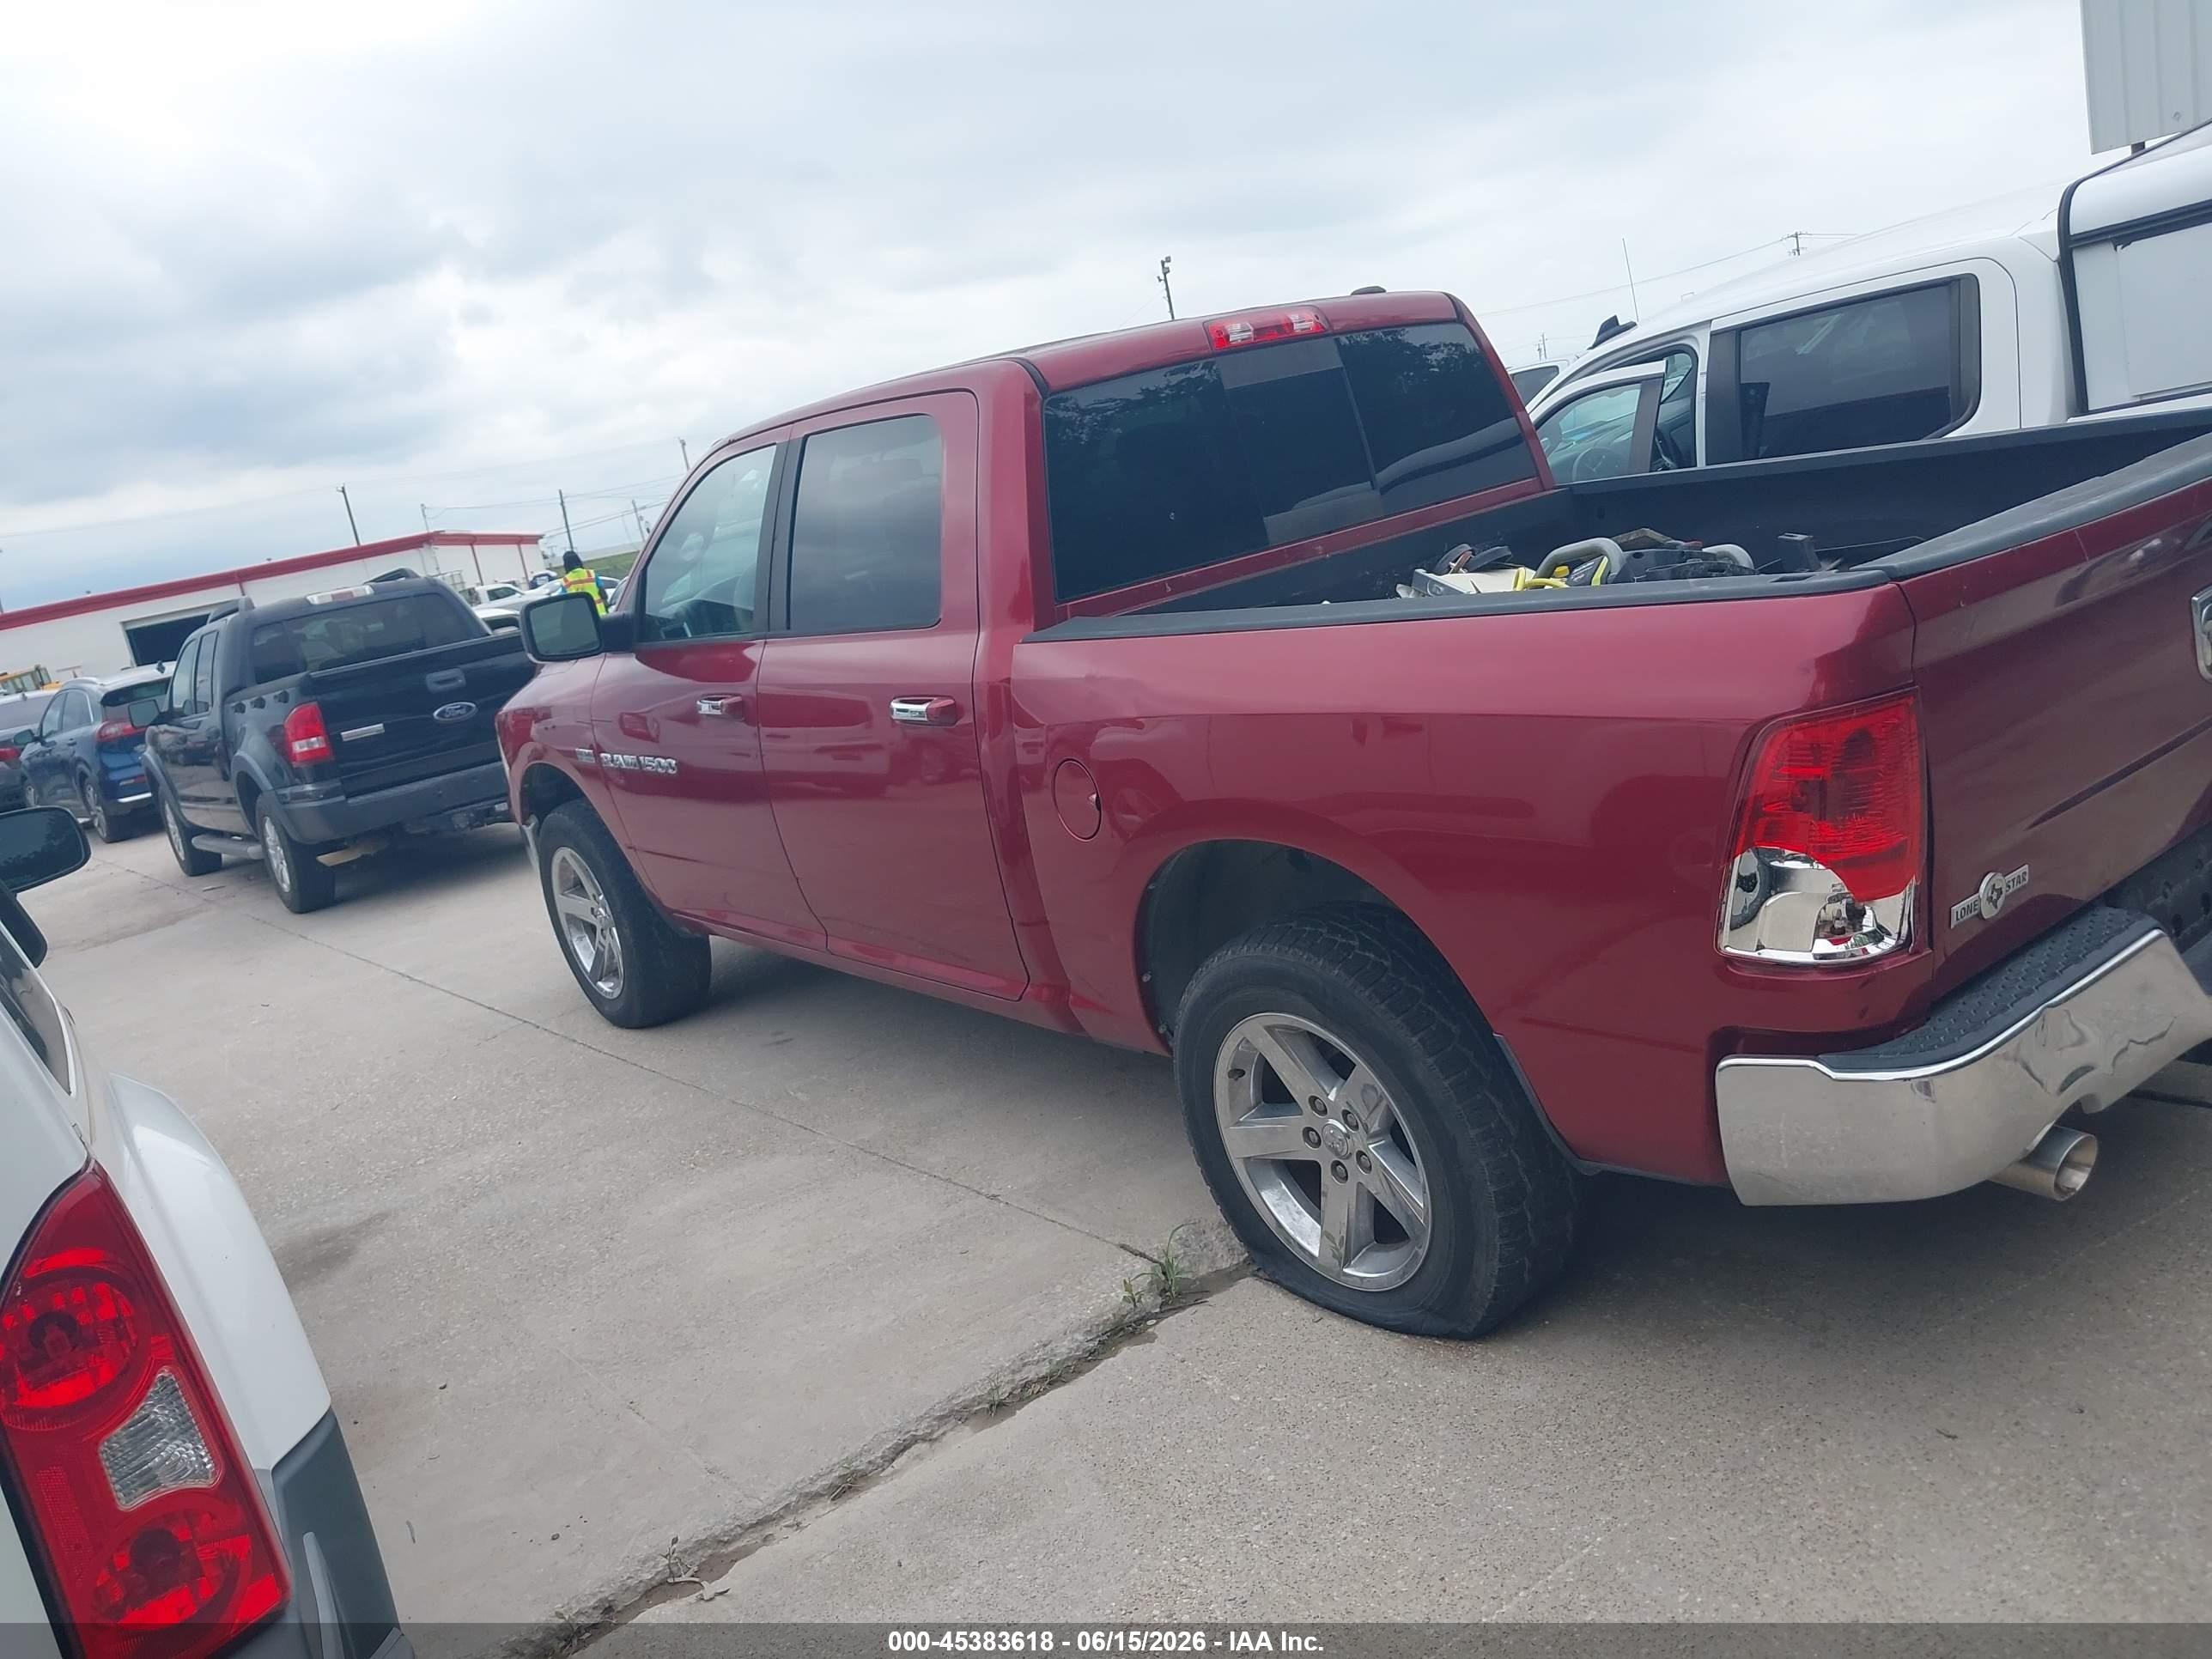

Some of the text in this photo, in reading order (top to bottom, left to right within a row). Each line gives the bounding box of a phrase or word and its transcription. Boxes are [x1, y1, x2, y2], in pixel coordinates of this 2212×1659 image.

[600, 752, 640, 769] RAM
[638, 756, 678, 775] 1500
[1955, 871, 2027, 921] LONE STAR
